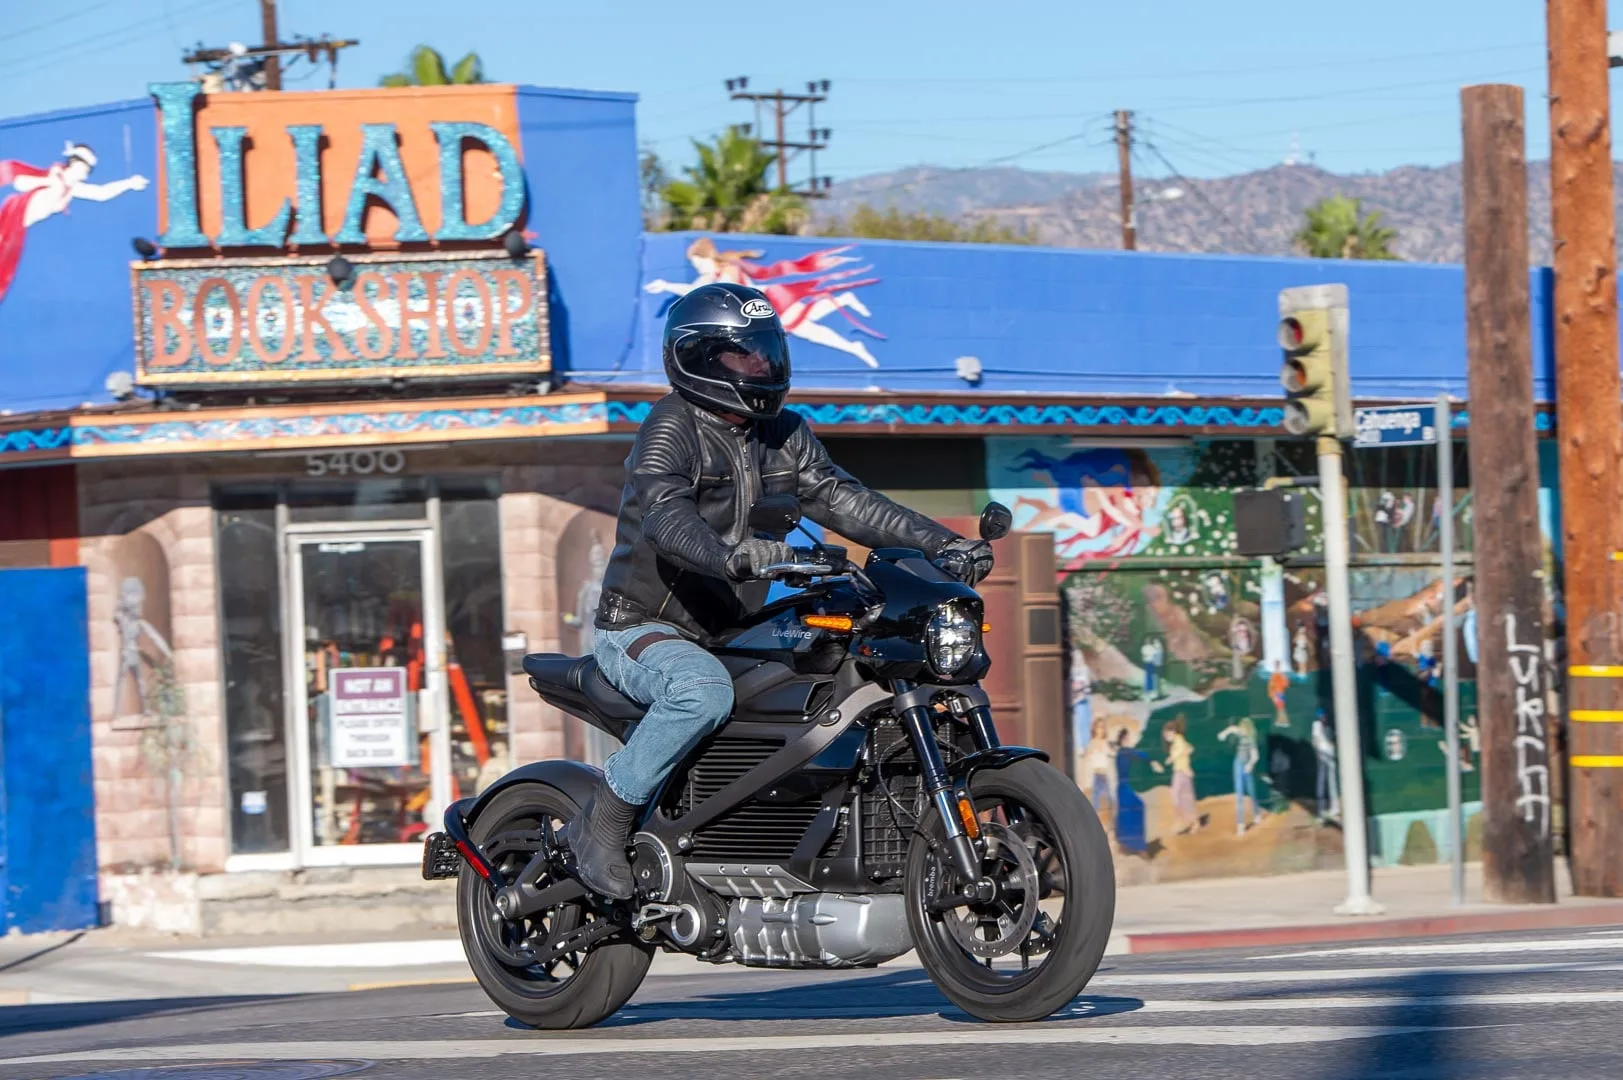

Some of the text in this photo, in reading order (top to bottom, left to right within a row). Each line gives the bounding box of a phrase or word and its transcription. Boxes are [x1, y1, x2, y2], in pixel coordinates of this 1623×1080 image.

[148, 82, 526, 248] ILIAD
[142, 268, 532, 367] BOOKSHOP
[306, 451, 405, 476] 5400
[771, 628, 812, 639] LiveWire
[927, 866, 936, 897] brembo
